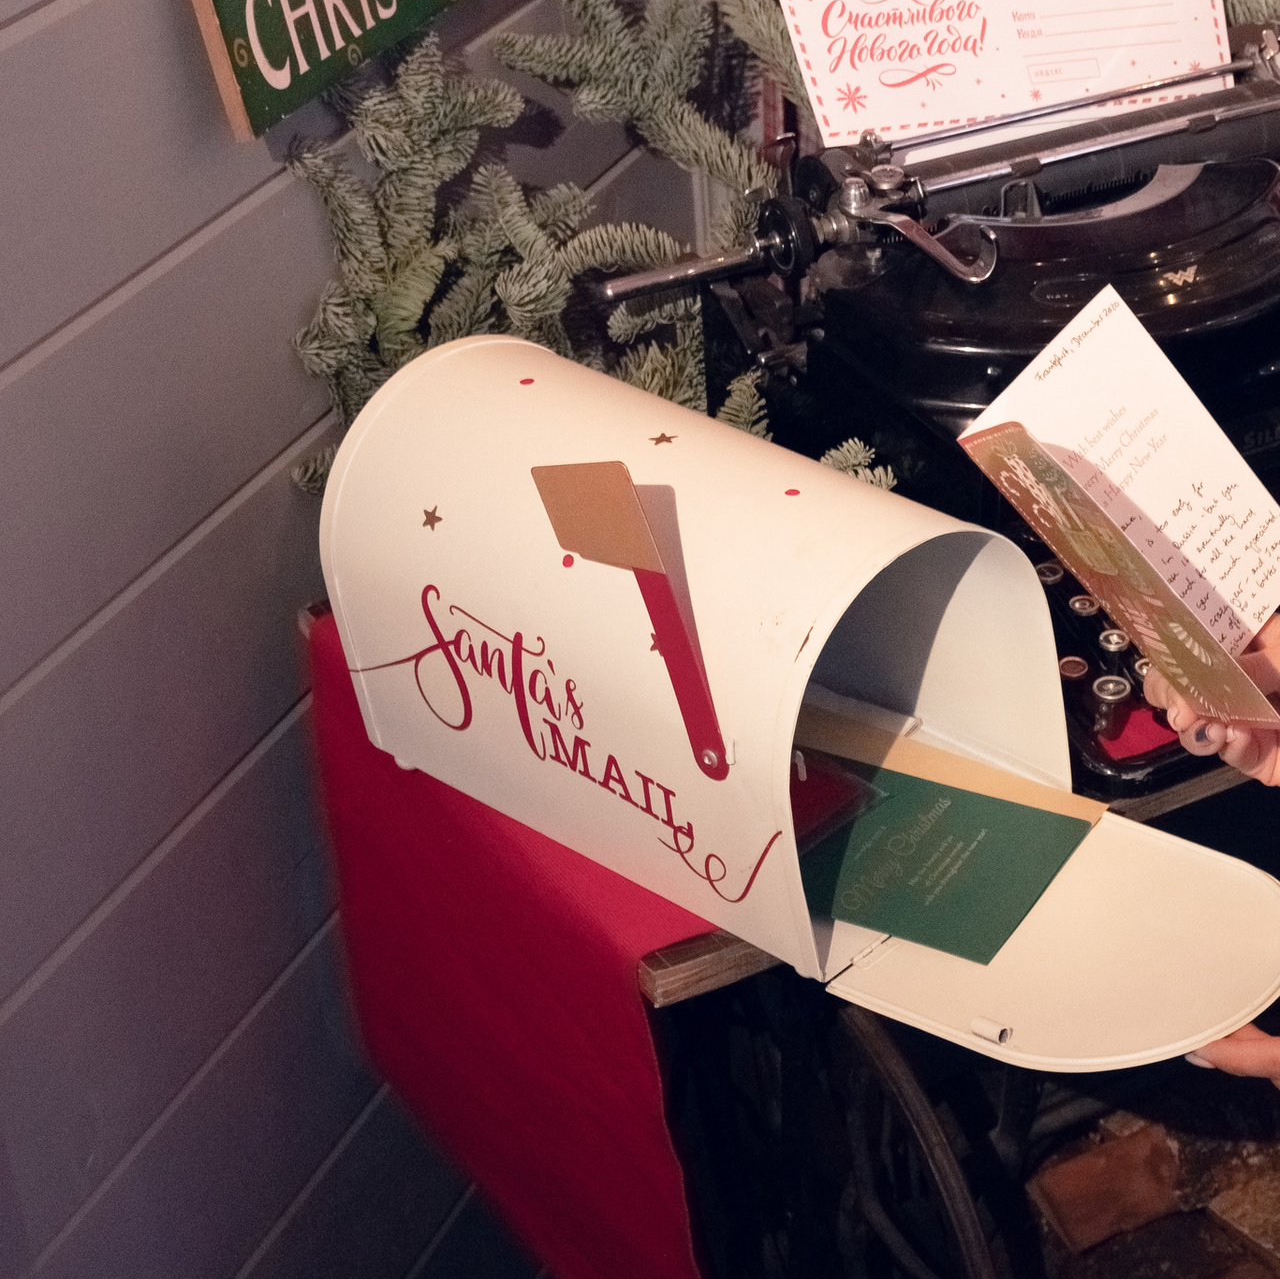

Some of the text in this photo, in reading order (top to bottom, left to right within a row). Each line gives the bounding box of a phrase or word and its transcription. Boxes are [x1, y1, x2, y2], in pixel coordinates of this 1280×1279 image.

[827, 17, 987, 73] Нового года!
[1102, 301, 1120, 317] 2020
[1063, 406, 1126, 469] With best wishes
[1095, 447, 1123, 475] Merry
[1119, 408, 1159, 448] Christmas
[1104, 471, 1134, 502] Happy
[1129, 452, 1151, 474] New
[1147, 434, 1168, 453] Year
[400, 584, 584, 760] Santa's
